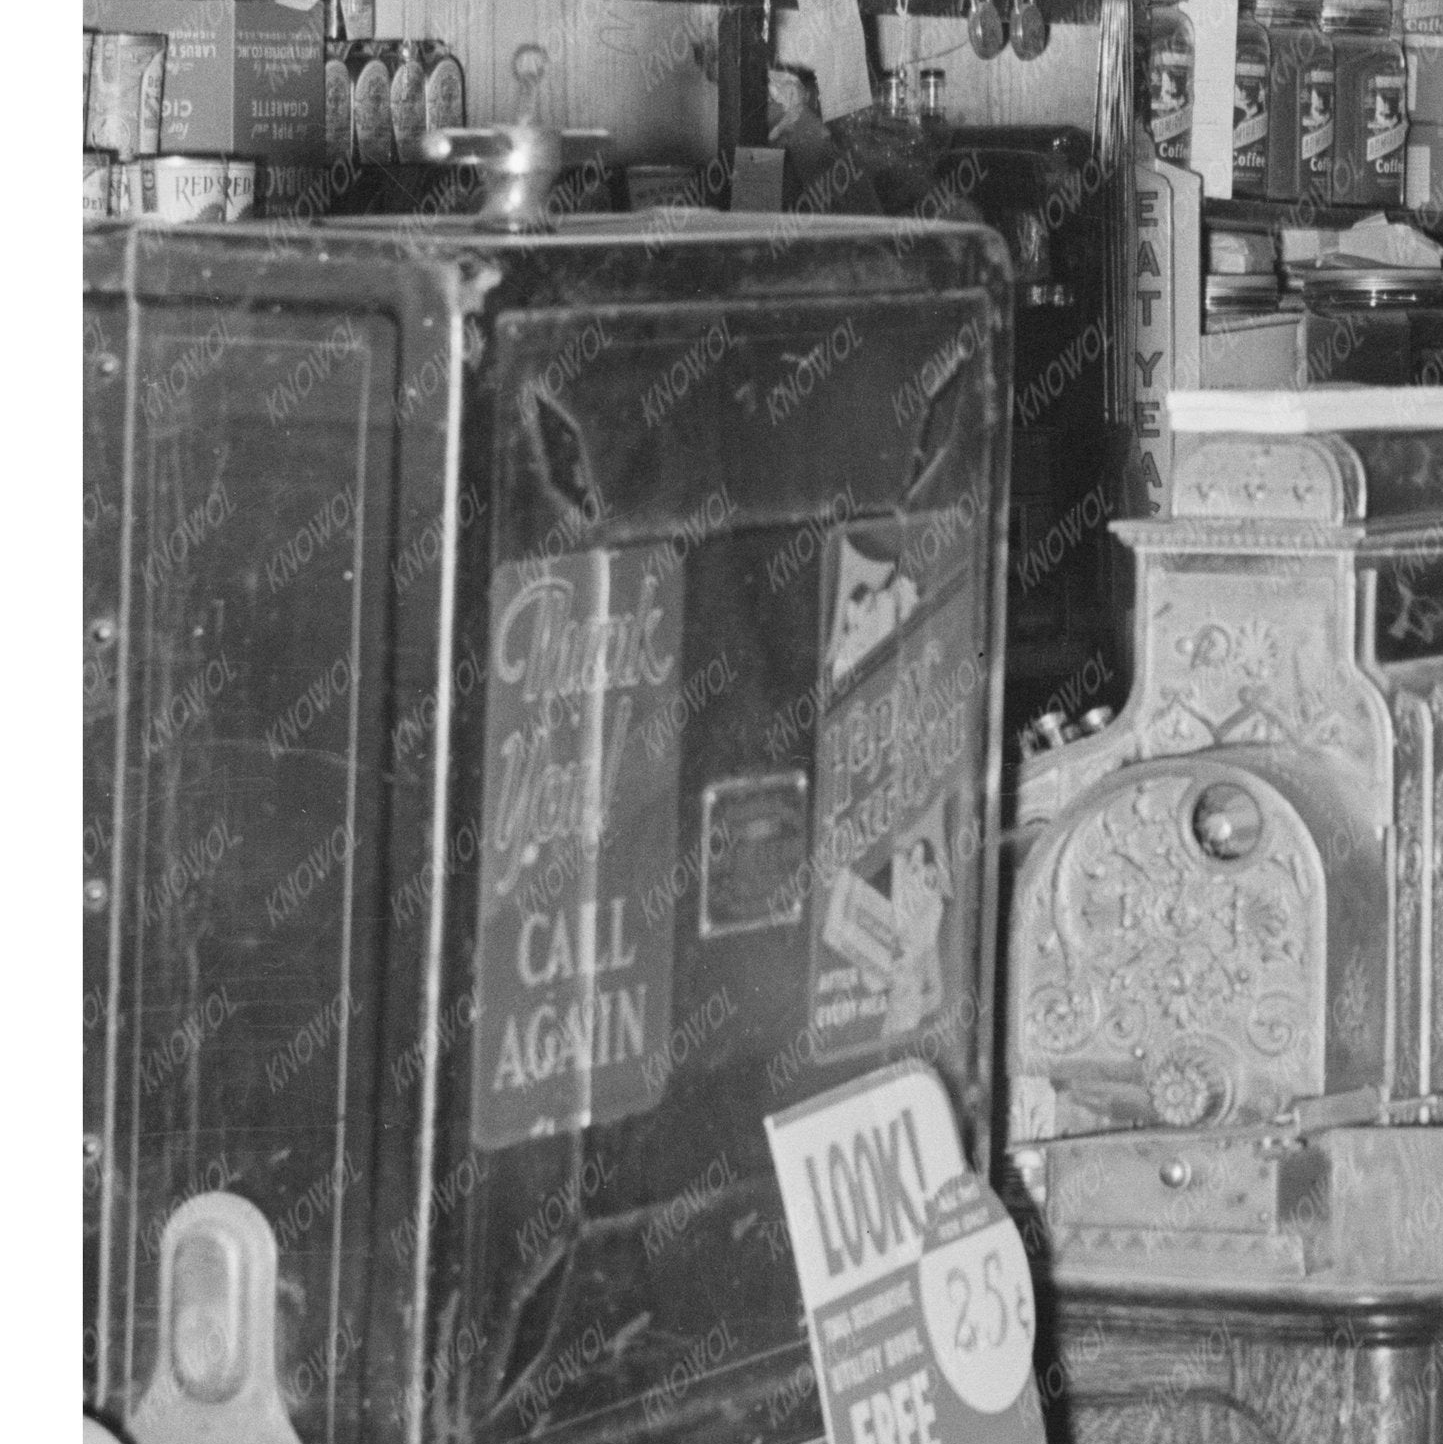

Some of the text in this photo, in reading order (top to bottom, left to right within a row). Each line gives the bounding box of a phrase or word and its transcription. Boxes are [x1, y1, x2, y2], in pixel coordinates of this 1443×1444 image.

[251, 100, 308, 117] CIGARETTE
[1136, 191, 1162, 327] EAT
[517, 897, 638, 986] CALL
[494, 983, 648, 1091] AGAIN
[806, 1108, 929, 1277] LOOK!
[946, 1249, 1032, 1352] 25¢
